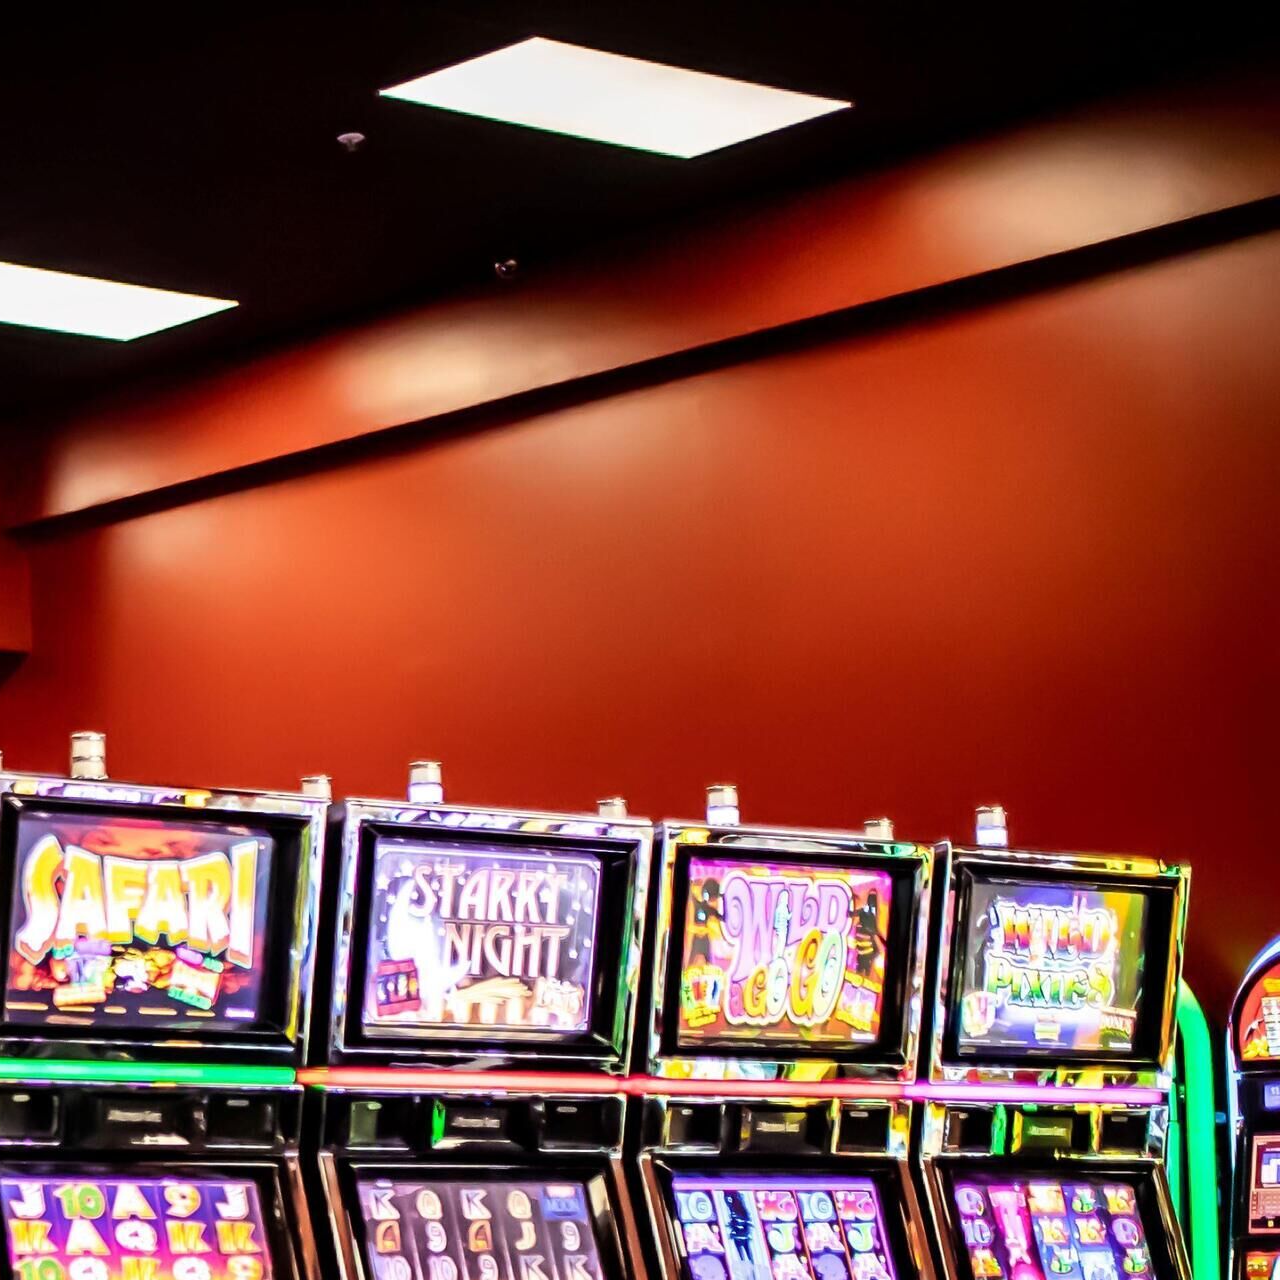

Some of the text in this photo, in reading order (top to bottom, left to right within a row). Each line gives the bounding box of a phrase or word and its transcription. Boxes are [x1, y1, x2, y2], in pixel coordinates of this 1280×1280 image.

[15, 834, 258, 968] SAFARI
[408, 863, 569, 924] STARRY
[445, 922, 569, 978] NIGHT
[987, 954, 1113, 1010] PIXIES
[10, 1182, 249, 1219] J 10 A 9 J
[368, 1189, 400, 1219] K
[461, 1189, 491, 1219] K
[8, 1219, 262, 1255] K A Q K K
[427, 1222, 446, 1252] 9
[516, 1222, 536, 1250] J
[560, 1222, 580, 1251] 9
